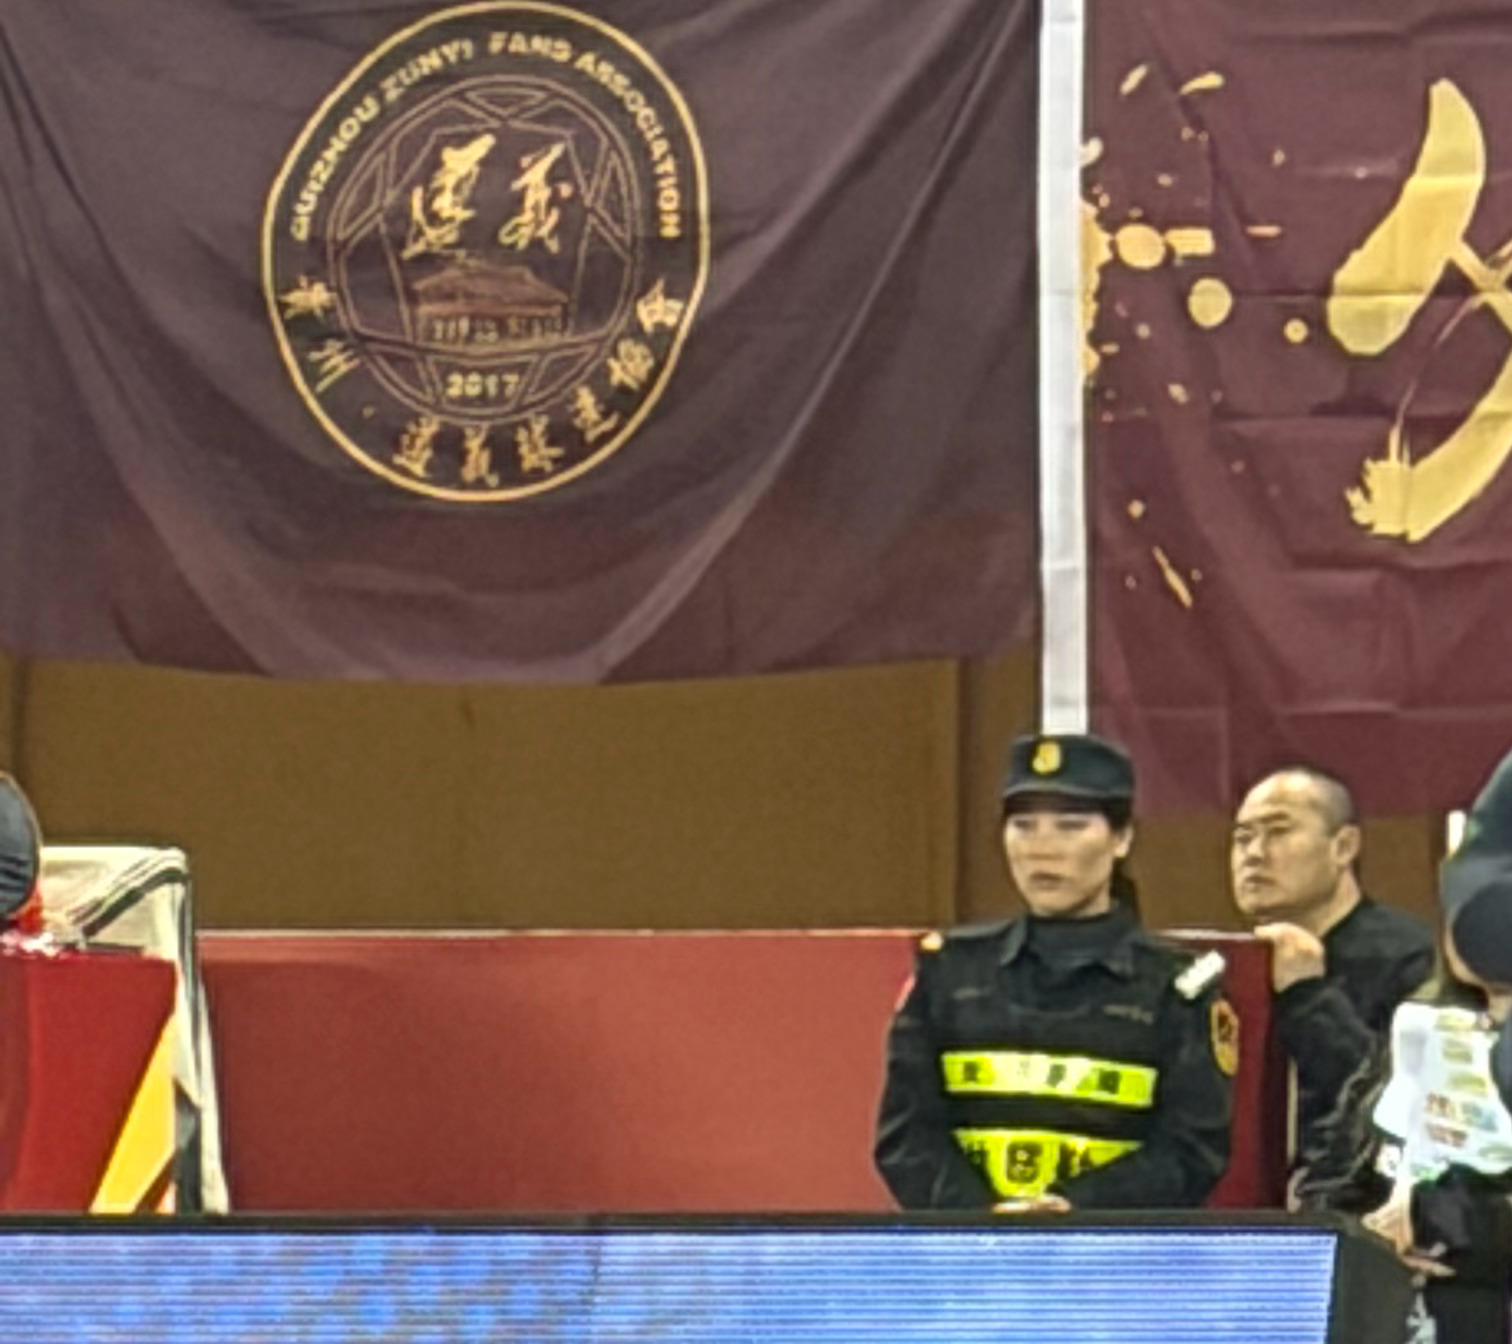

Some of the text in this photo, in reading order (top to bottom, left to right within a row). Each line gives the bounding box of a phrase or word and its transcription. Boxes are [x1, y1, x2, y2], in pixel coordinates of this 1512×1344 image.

[291, 96, 378, 240] GUIZHOU
[489, 32, 575, 63] FANS
[575, 52, 682, 238] ASSOCIATION
[446, 373, 519, 398] 2017
